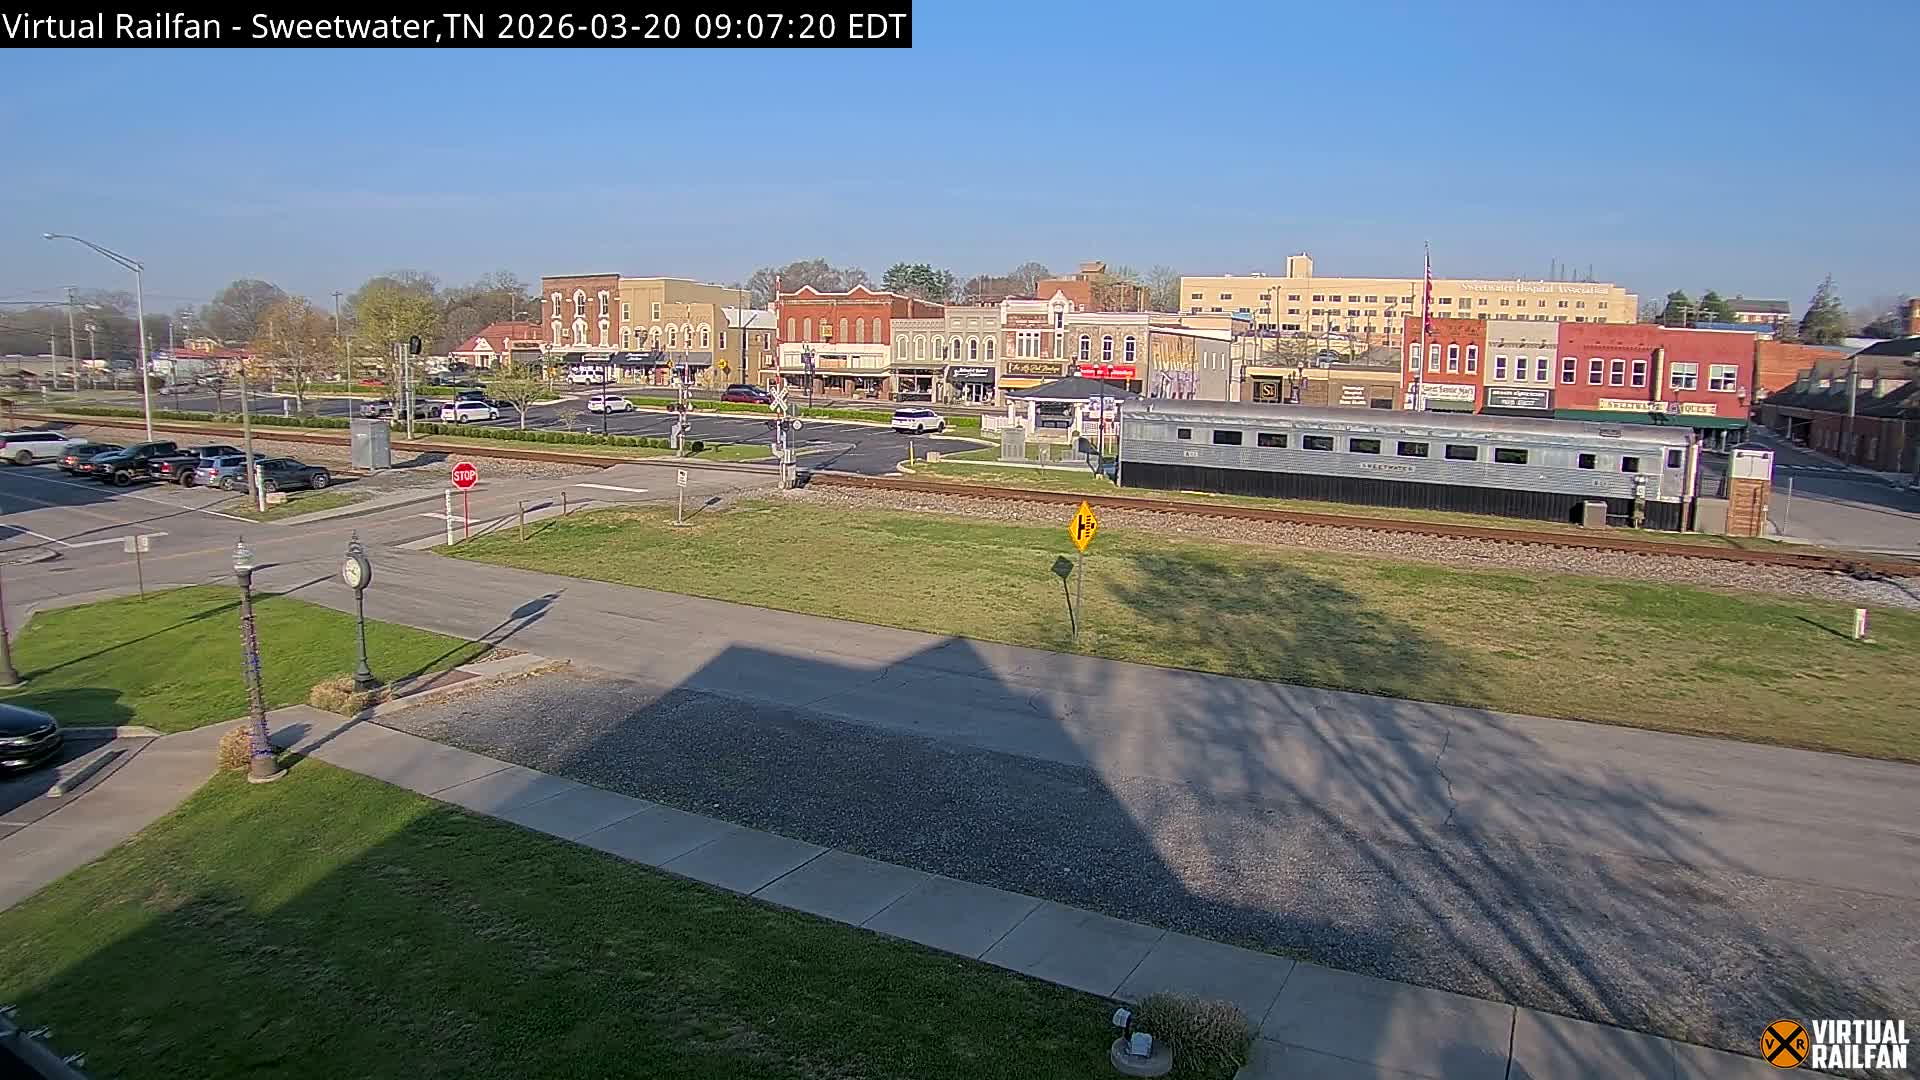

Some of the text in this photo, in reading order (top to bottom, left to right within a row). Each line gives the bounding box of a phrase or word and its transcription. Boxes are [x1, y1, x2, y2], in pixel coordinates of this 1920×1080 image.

[1462, 283, 1515, 293] Sweetwater
[1516, 284, 1554, 294] Hospital
[453, 470, 476, 482] STOP
